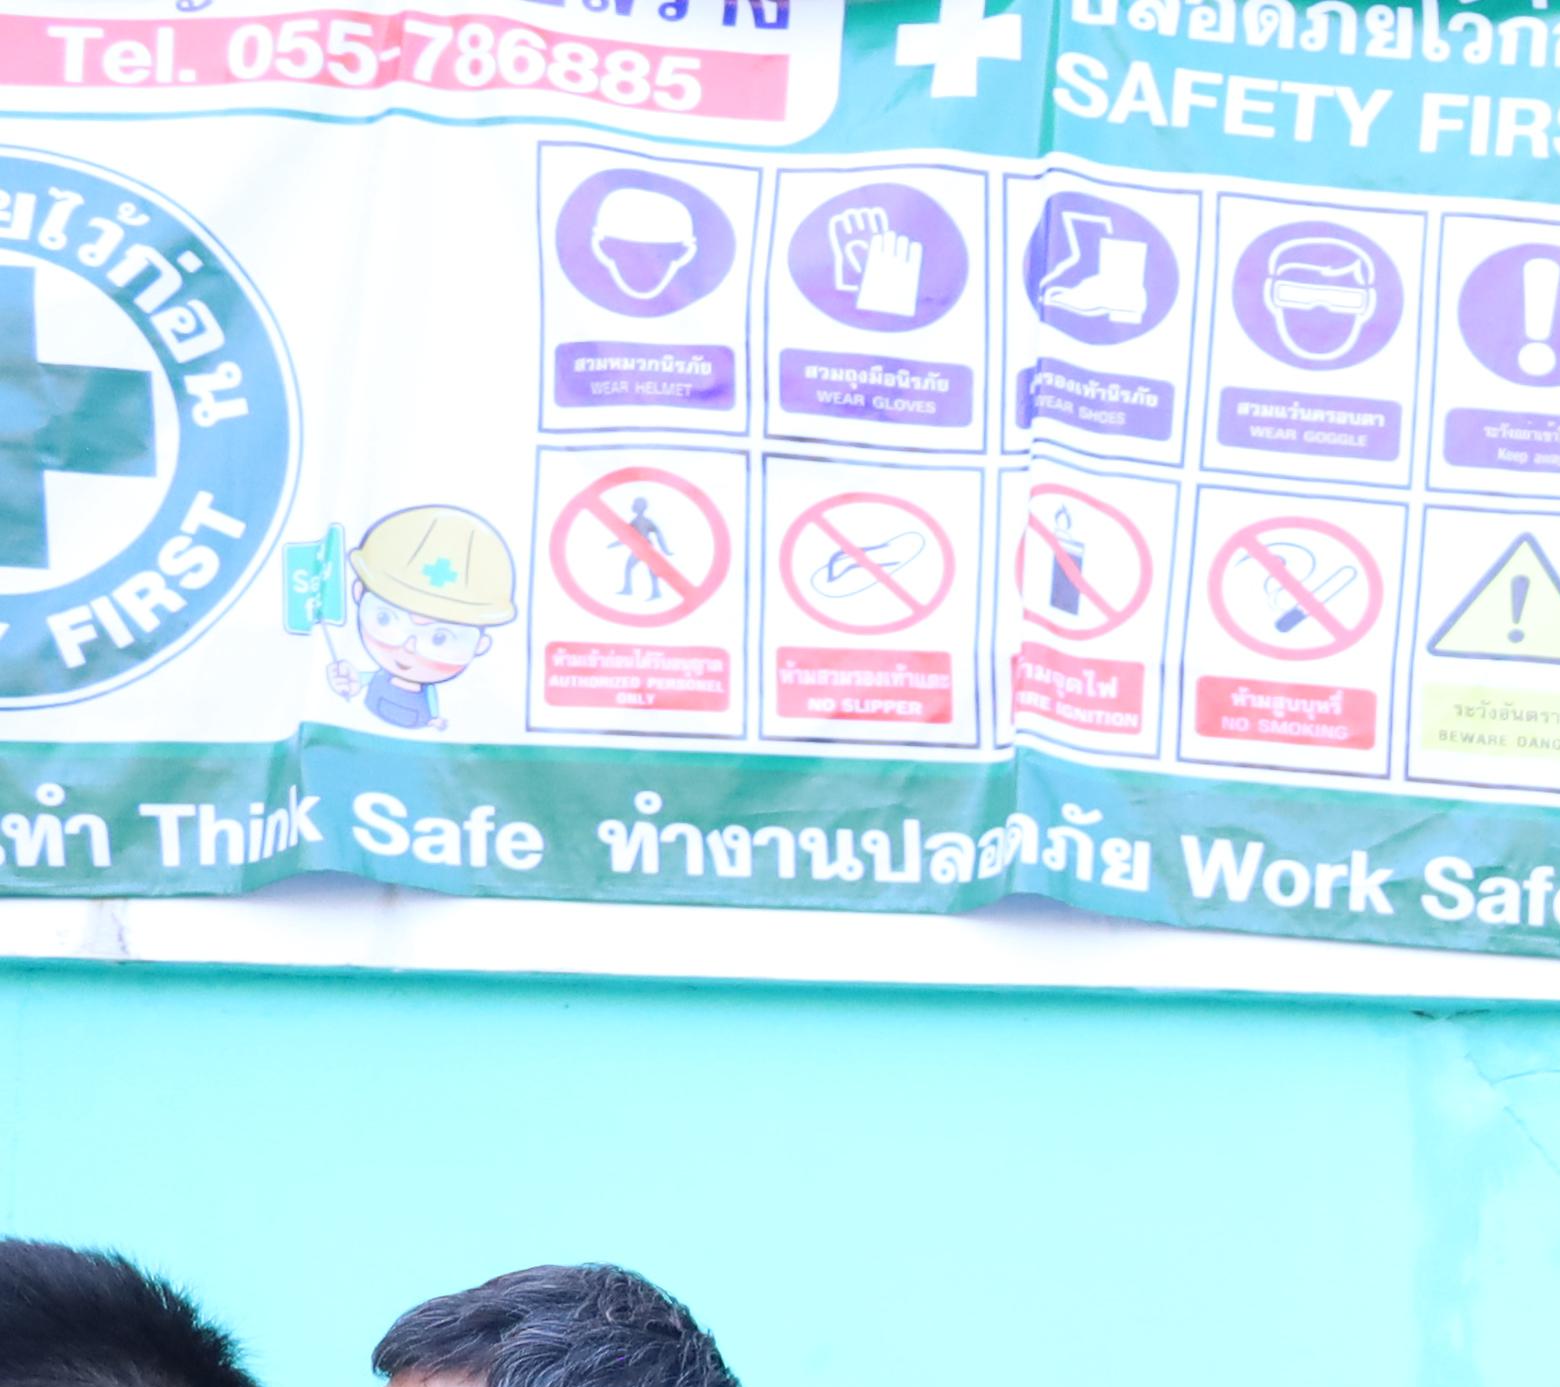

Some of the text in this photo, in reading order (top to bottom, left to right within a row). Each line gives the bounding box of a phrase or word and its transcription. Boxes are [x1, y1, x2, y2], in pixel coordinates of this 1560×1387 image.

[47, 20, 703, 113] Tel. 055-786885
[1053, 50, 1394, 149] SAFETY
[591, 380, 693, 398] WEAR HELMET
[816, 390, 937, 415] WEAR GLOVES
[1078, 406, 1127, 426] SHOES
[1250, 425, 1368, 448] WEAR GOGGLE
[1497, 447, 1529, 464] Keep
[46, 489, 247, 669] FIRST
[1018, 657, 1118, 700] ามจุดไฟ
[615, 691, 656, 705] ONLY
[807, 697, 923, 716] NO SLIPPER
[1055, 701, 1140, 729] IGNITION
[1221, 715, 1350, 741] NO SMOKING
[1438, 729, 1508, 748] BEWARE
[0, 783, 112, 871] ทำ
[139, 785, 325, 869] Think
[352, 792, 546, 873] Safe
[1180, 834, 1396, 915] Work
